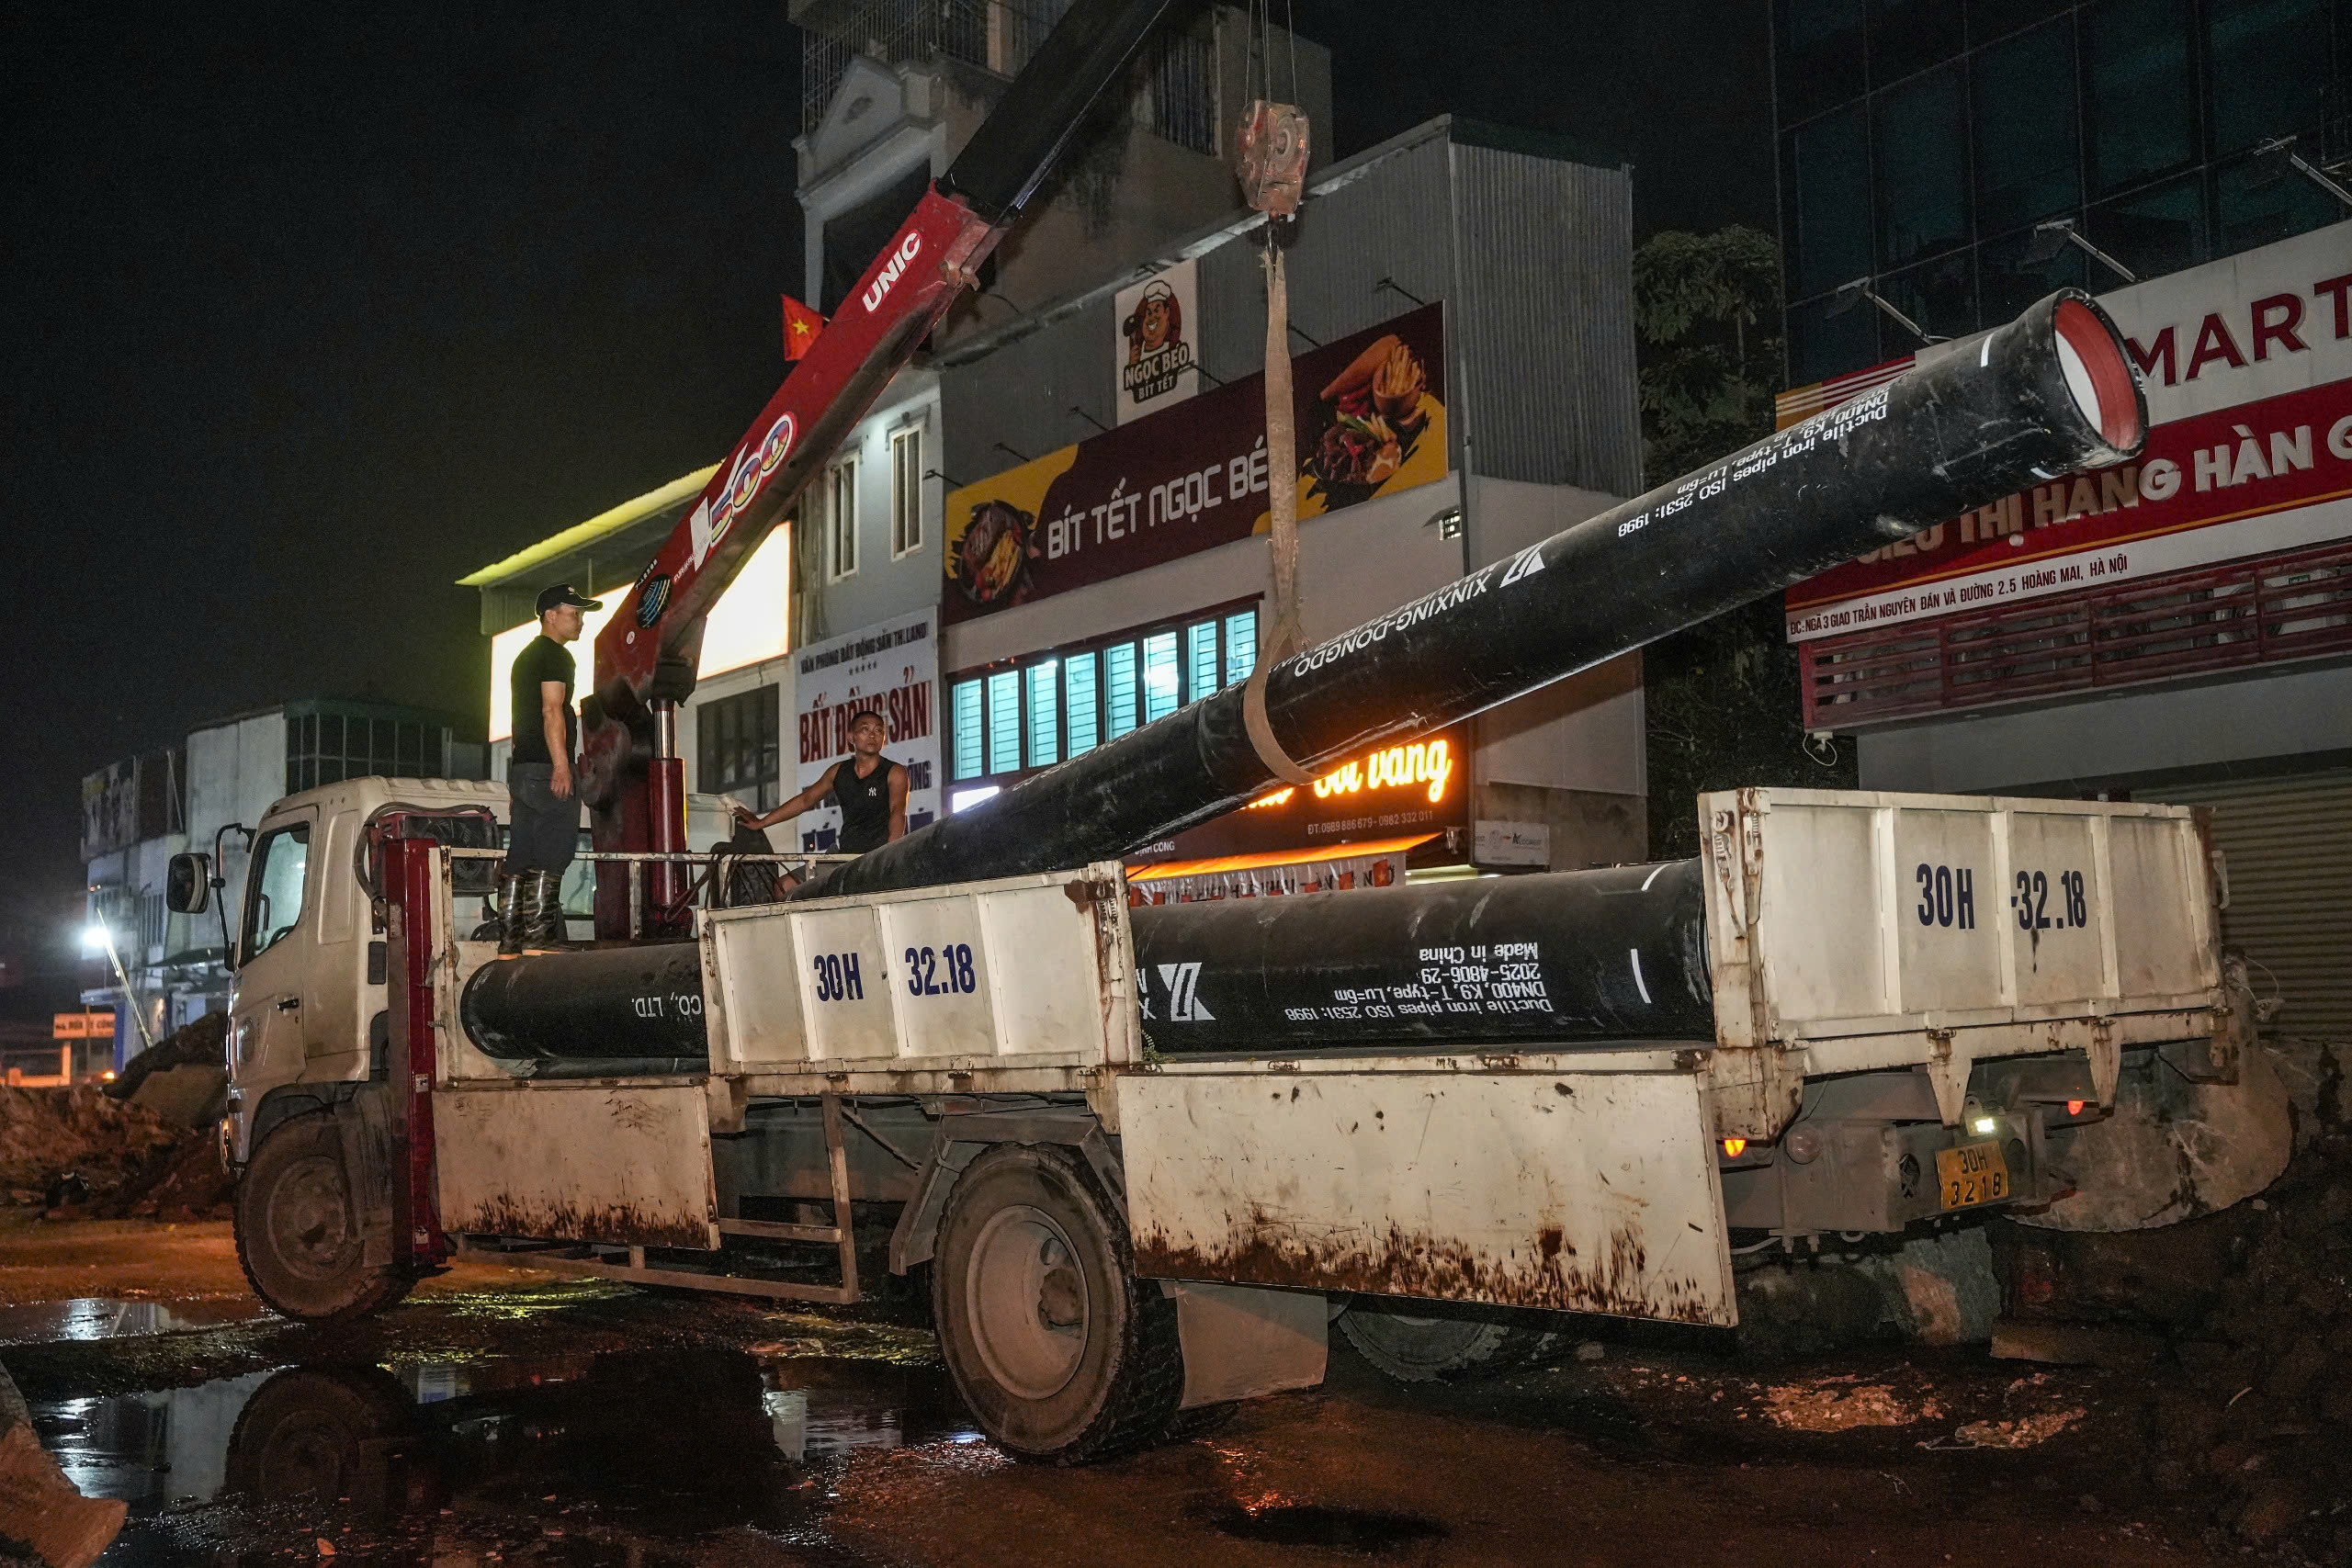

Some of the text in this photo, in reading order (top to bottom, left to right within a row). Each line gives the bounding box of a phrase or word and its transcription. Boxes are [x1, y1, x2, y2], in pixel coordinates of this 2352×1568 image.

[863, 231, 921, 312] UNIC
[1125, 344, 1190, 389] NGỌC BÉO
[1823, 404, 1886, 441] Ductile
[1783, 437, 1815, 459] iron
[2193, 424, 2314, 492] HÀN
[1733, 452, 1777, 482] pipes
[1047, 434, 1269, 559] BÍT TẾT NGỌC BÉ
[1700, 478, 1725, 500] ISO
[1619, 513, 1649, 536] 1998
[1824, 615, 1829, 628] 3
[1830, 611, 1850, 627] GIAO
[1880, 597, 1916, 618] NGUYÊN
[1943, 588, 1956, 605] VÀ
[1960, 582, 1994, 603] ĐƯỜNG
[1998, 579, 2016, 595] 2.5
[2021, 570, 2056, 591] HOÀNG
[2090, 558, 2105, 577] HÀ
[2109, 553, 2128, 574] NỘI
[1295, 573, 1491, 677] XINXING-DONGDO
[799, 692, 831, 763] BẤT
[888, 665, 932, 743] SẢN
[1917, 863, 1974, 930] 30H
[1419, 942, 1538, 964] Made in China
[814, 943, 976, 1001] 30H 32.18
[1421, 963, 1541, 984] 2025-4806-29
[631, 996, 663, 1018] LTD.
[1284, 1008, 1319, 1020] 1998
[1365, 1005, 1395, 1018] ISO
[1398, 1001, 1442, 1016] pipes
[1446, 1001, 1482, 1014] iron
[1487, 998, 1554, 1014] Ductile
[1958, 1145, 1988, 1174] 30H
[1950, 1172, 2001, 1205] 3218
